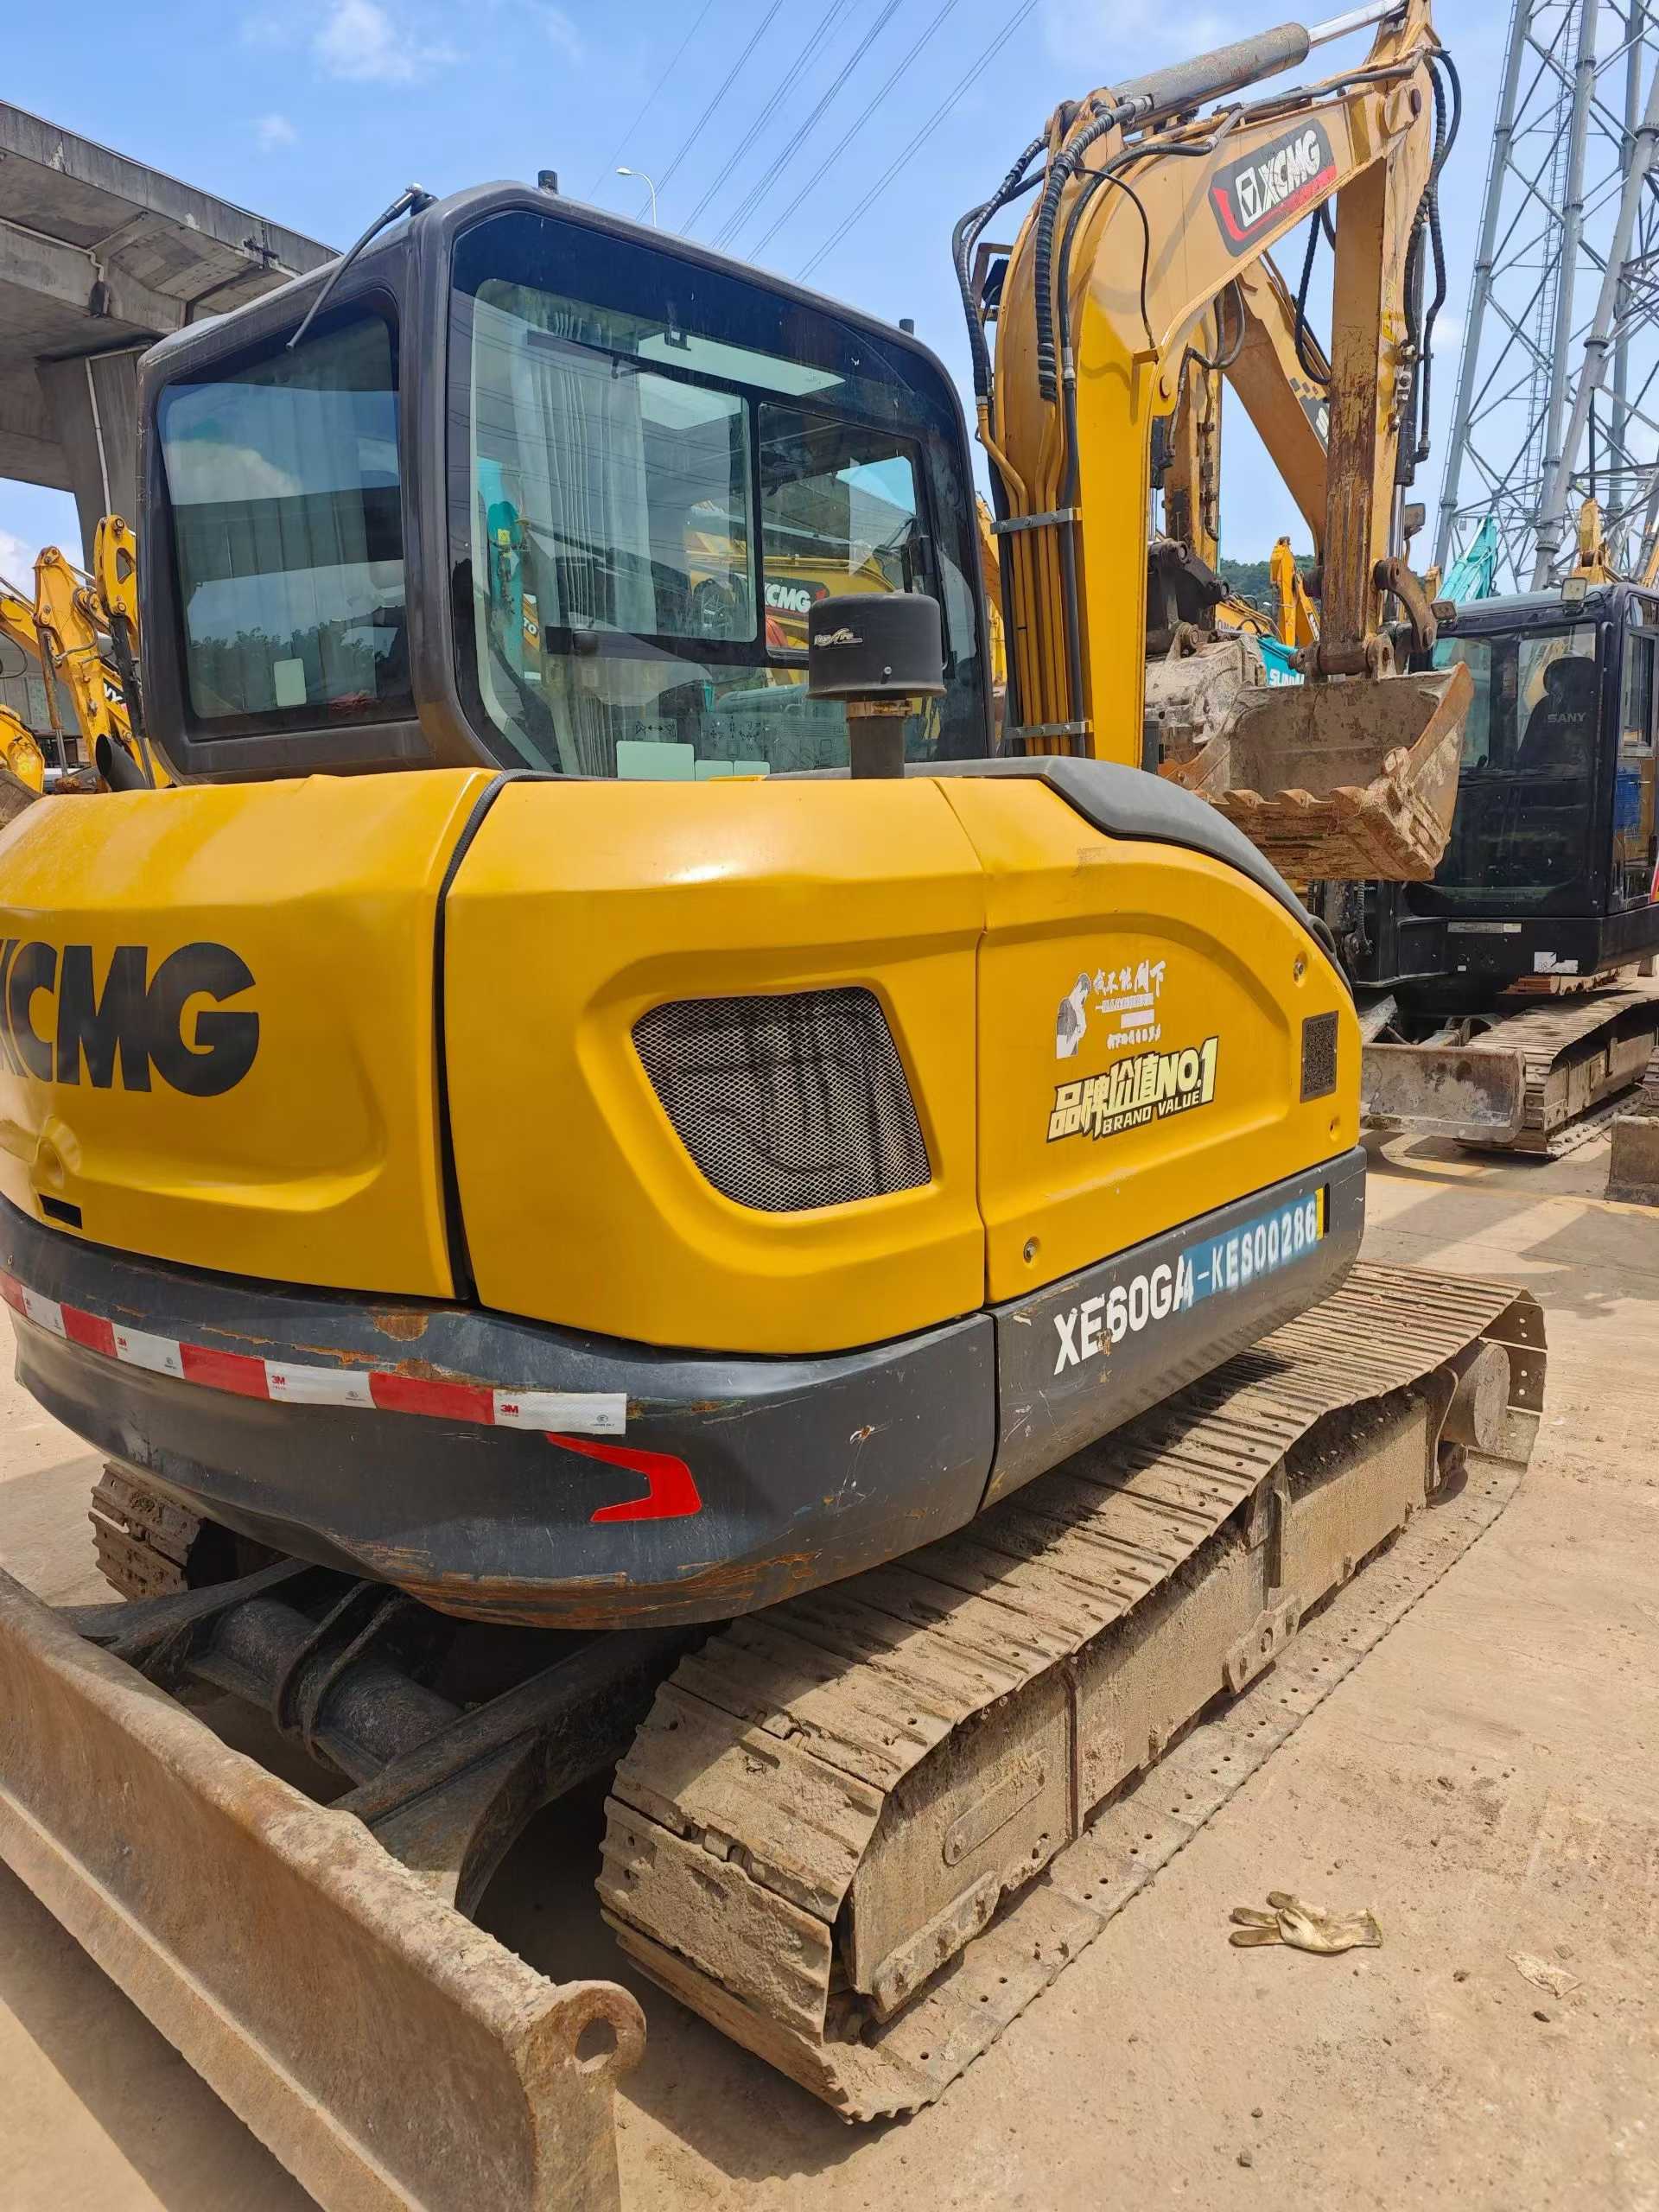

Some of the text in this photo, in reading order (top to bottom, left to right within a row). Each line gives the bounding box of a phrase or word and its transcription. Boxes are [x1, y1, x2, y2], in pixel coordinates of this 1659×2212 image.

[1258, 130, 1320, 213] XCMG
[765, 582, 810, 613] CMG
[1548, 712, 1586, 723] SANY
[1102, 1090, 1201, 1135] BRAND VALUE
[271, 1375, 285, 1385] 3M
[500, 1404, 518, 1414] 3M
